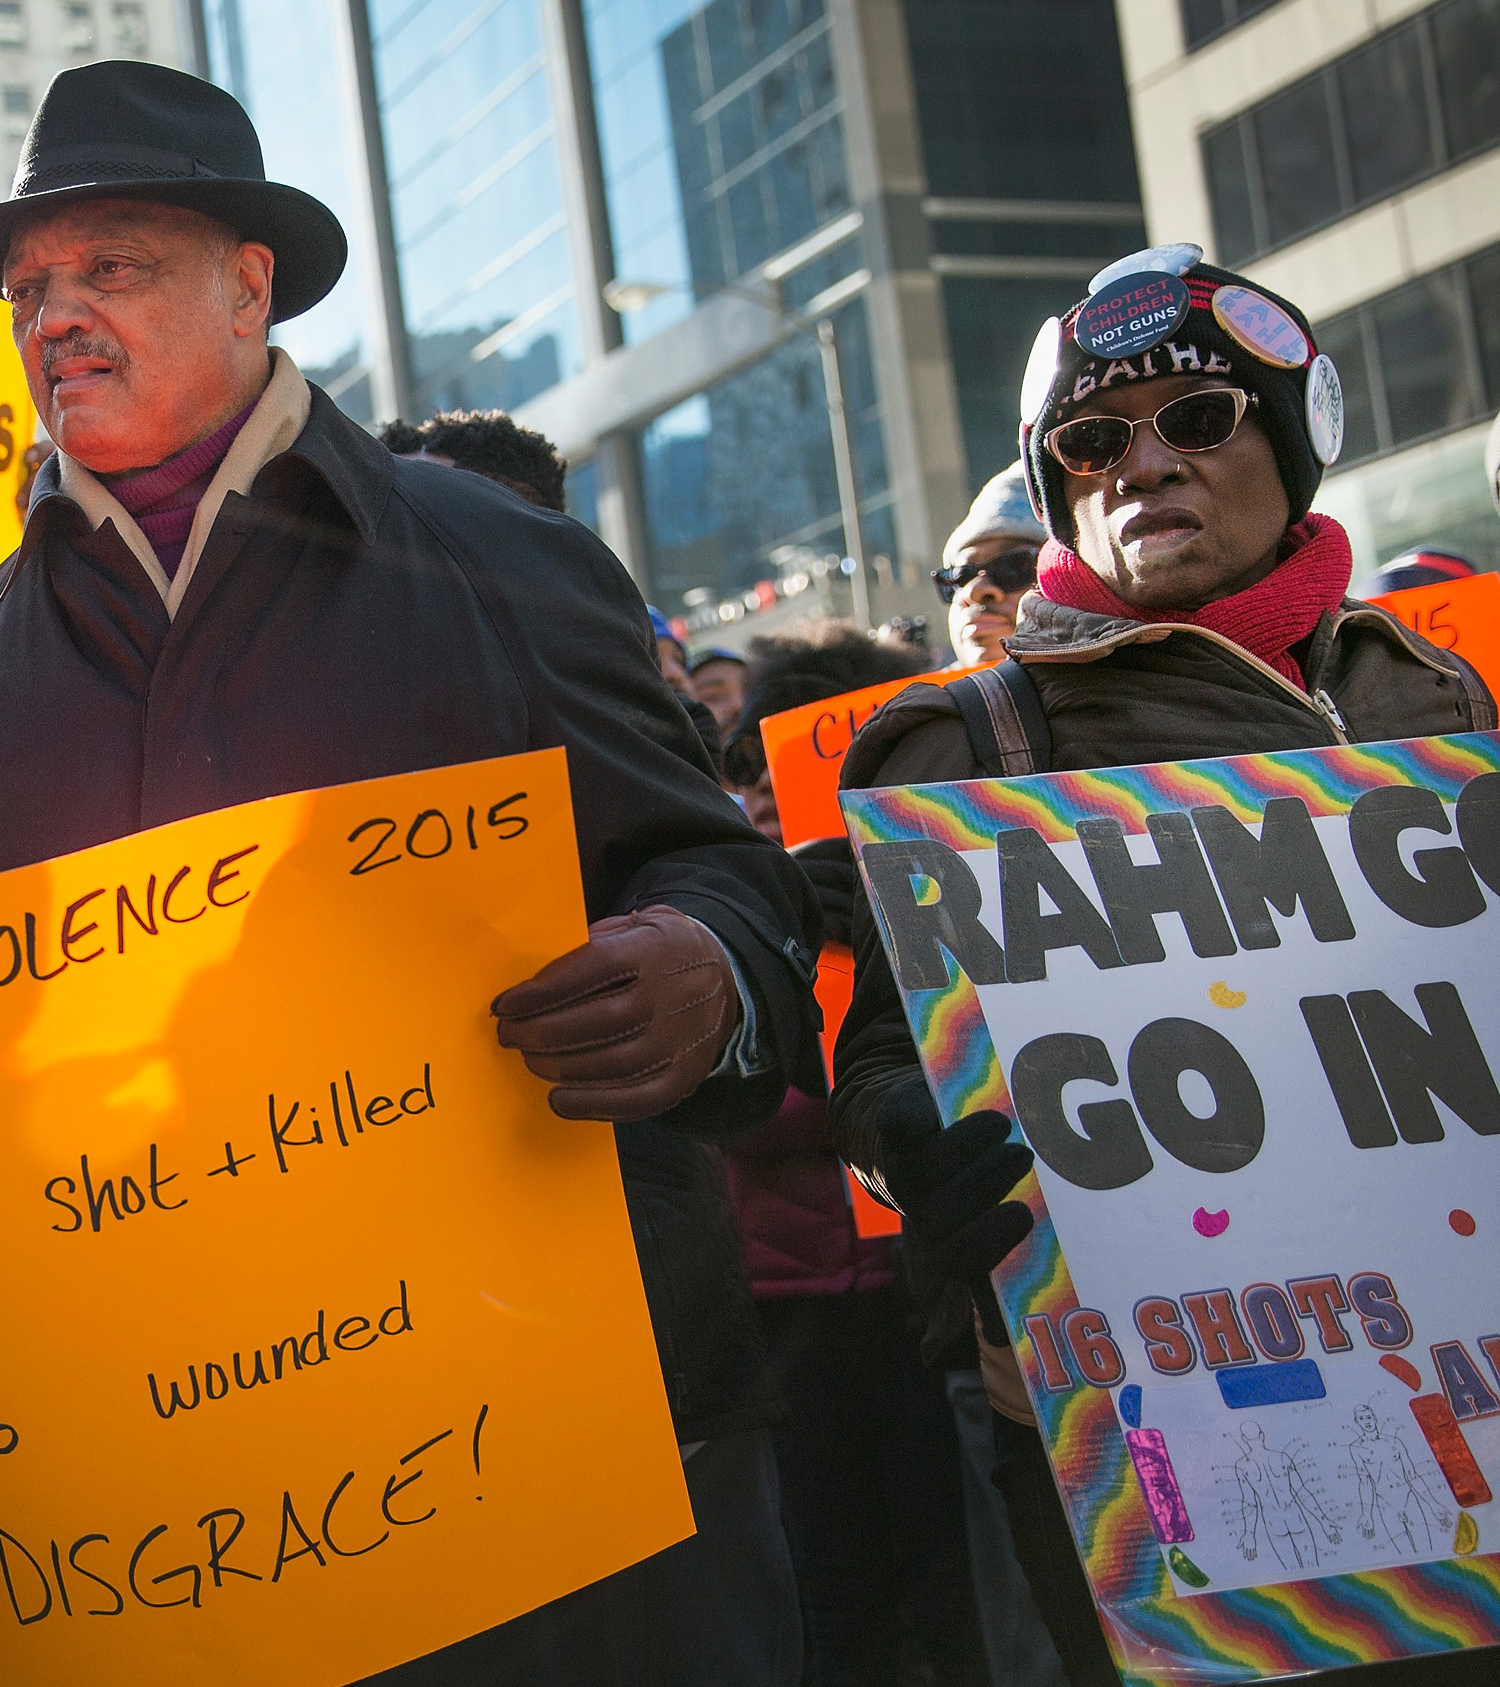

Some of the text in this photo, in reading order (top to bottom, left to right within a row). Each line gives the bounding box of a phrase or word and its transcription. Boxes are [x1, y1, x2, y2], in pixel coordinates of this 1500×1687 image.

[1085, 278, 1170, 321] PROTECT
[1089, 292, 1175, 333] CHILDREN
[1091, 306, 1178, 347] NOT GUNS
[348, 792, 529, 876] 2015
[861, 796, 1357, 990] RAHM
[1010, 981, 1500, 1191] GO IN
[147, 1280, 415, 1420] wounded
[1021, 1271, 1413, 1394] 16 SHOTS
